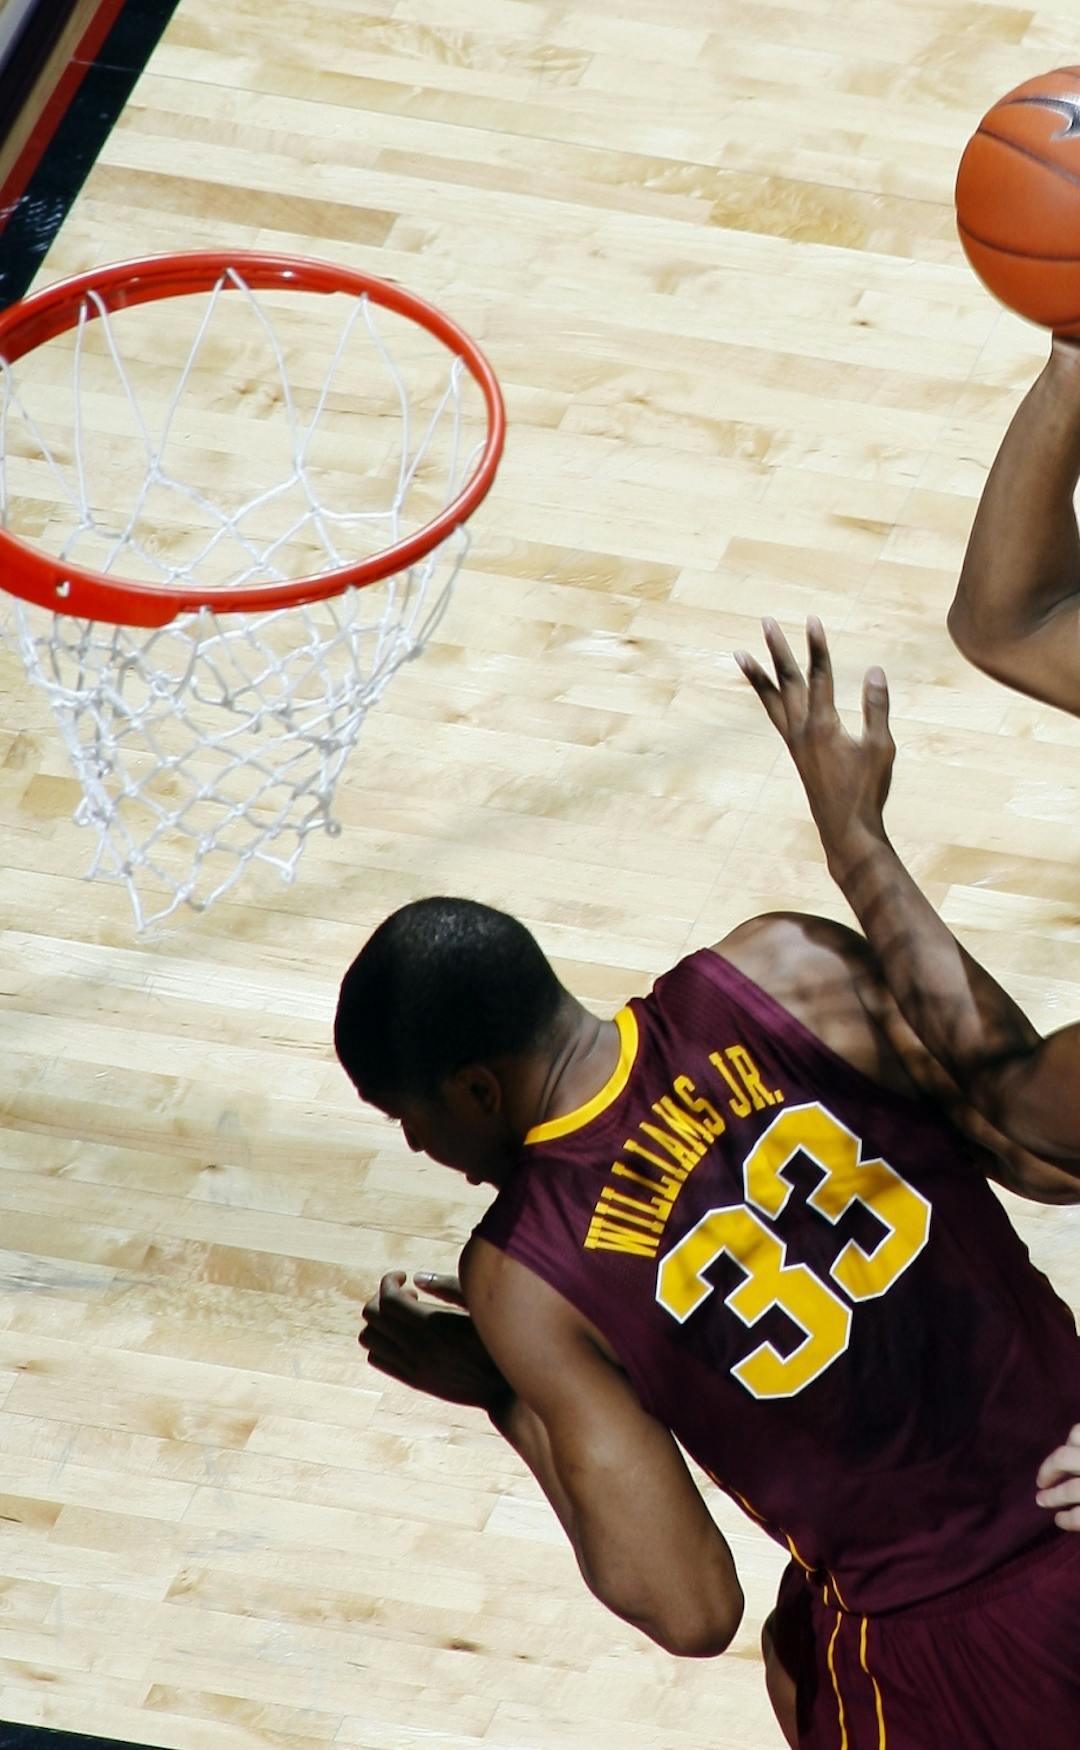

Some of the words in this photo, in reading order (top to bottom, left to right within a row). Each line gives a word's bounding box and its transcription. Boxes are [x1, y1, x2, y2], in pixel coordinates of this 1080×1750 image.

[584, 1075, 726, 1258] WILLIAMS
[709, 1045, 784, 1118] JR.
[655, 1101, 932, 1400] 33
